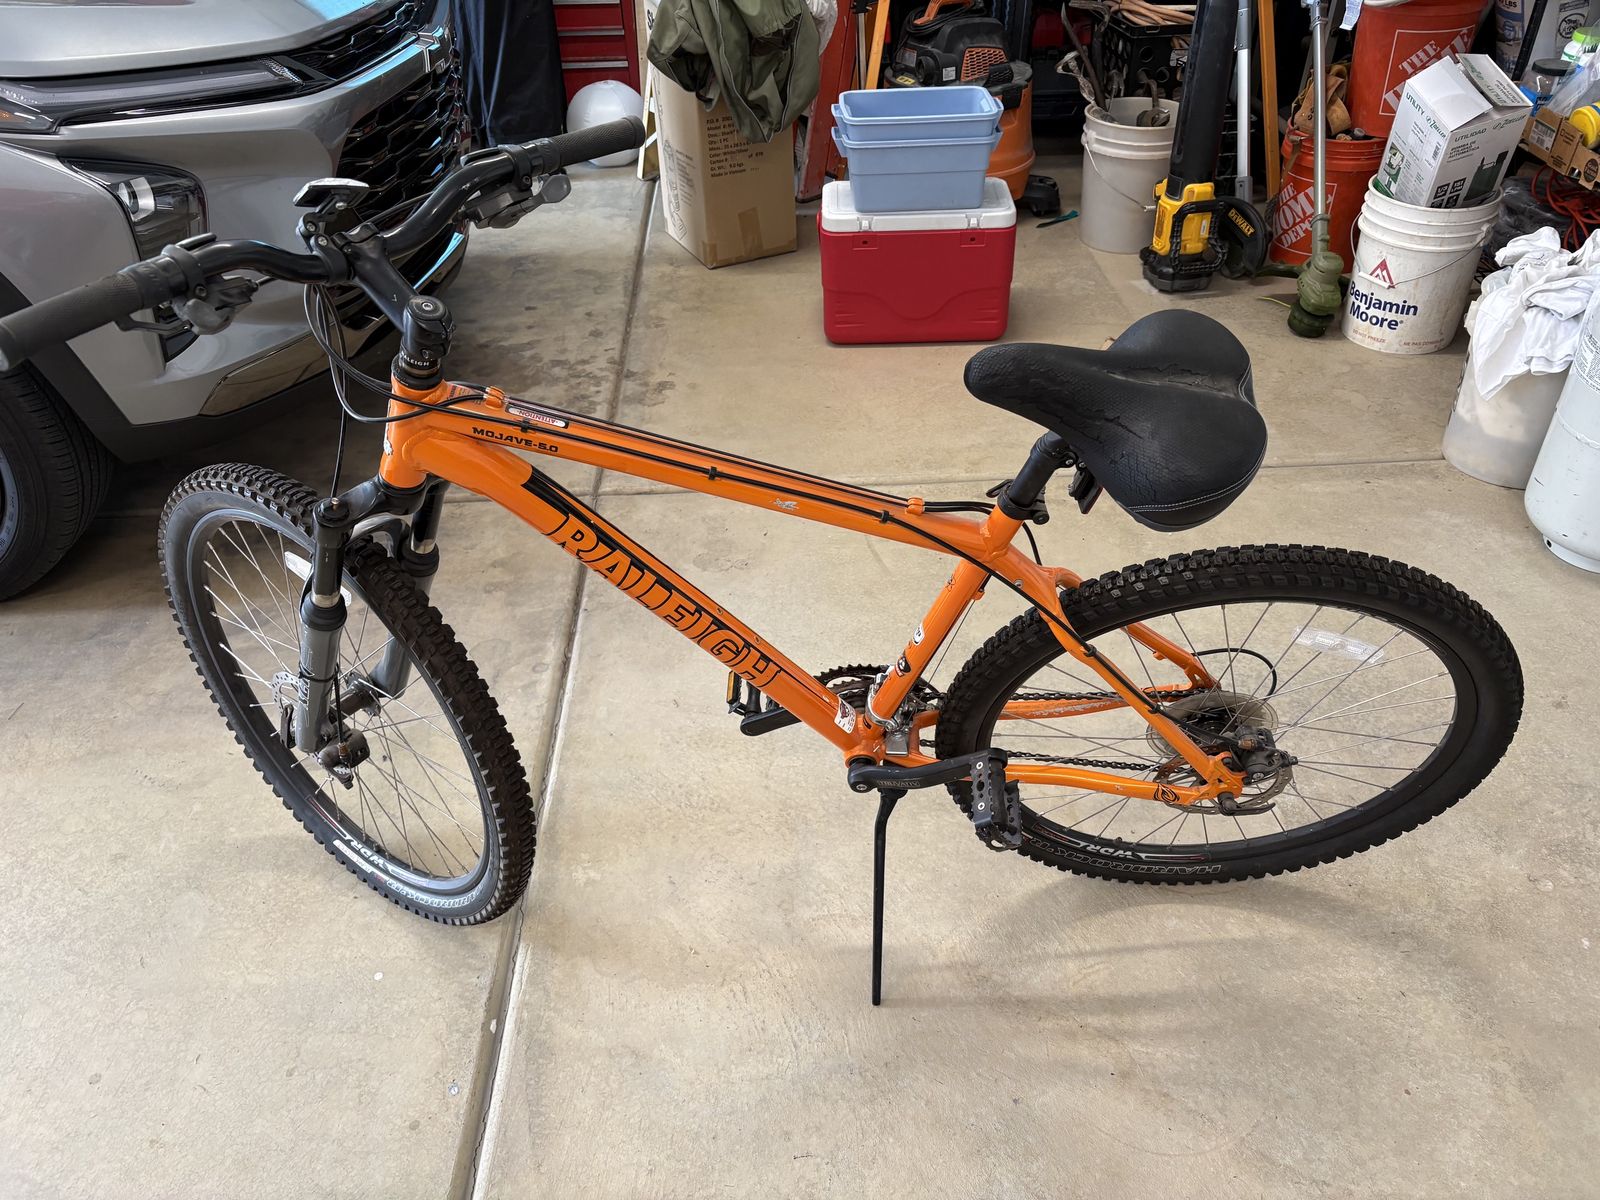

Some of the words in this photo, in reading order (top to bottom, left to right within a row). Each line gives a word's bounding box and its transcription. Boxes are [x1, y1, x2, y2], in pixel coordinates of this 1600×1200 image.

[1399, 40, 1441, 74] THE
[1405, 92, 1425, 116] UTILITY
[1454, 128, 1487, 142] UTILIDAD
[1272, 186, 1320, 238] HOM
[1349, 280, 1418, 316] Benjamin
[1349, 301, 1400, 331] Moore
[1367, 334, 1386, 343] FREEZE
[472, 426, 559, 453] MOJAVE-5.0
[542, 513, 782, 687] RALEIGH
